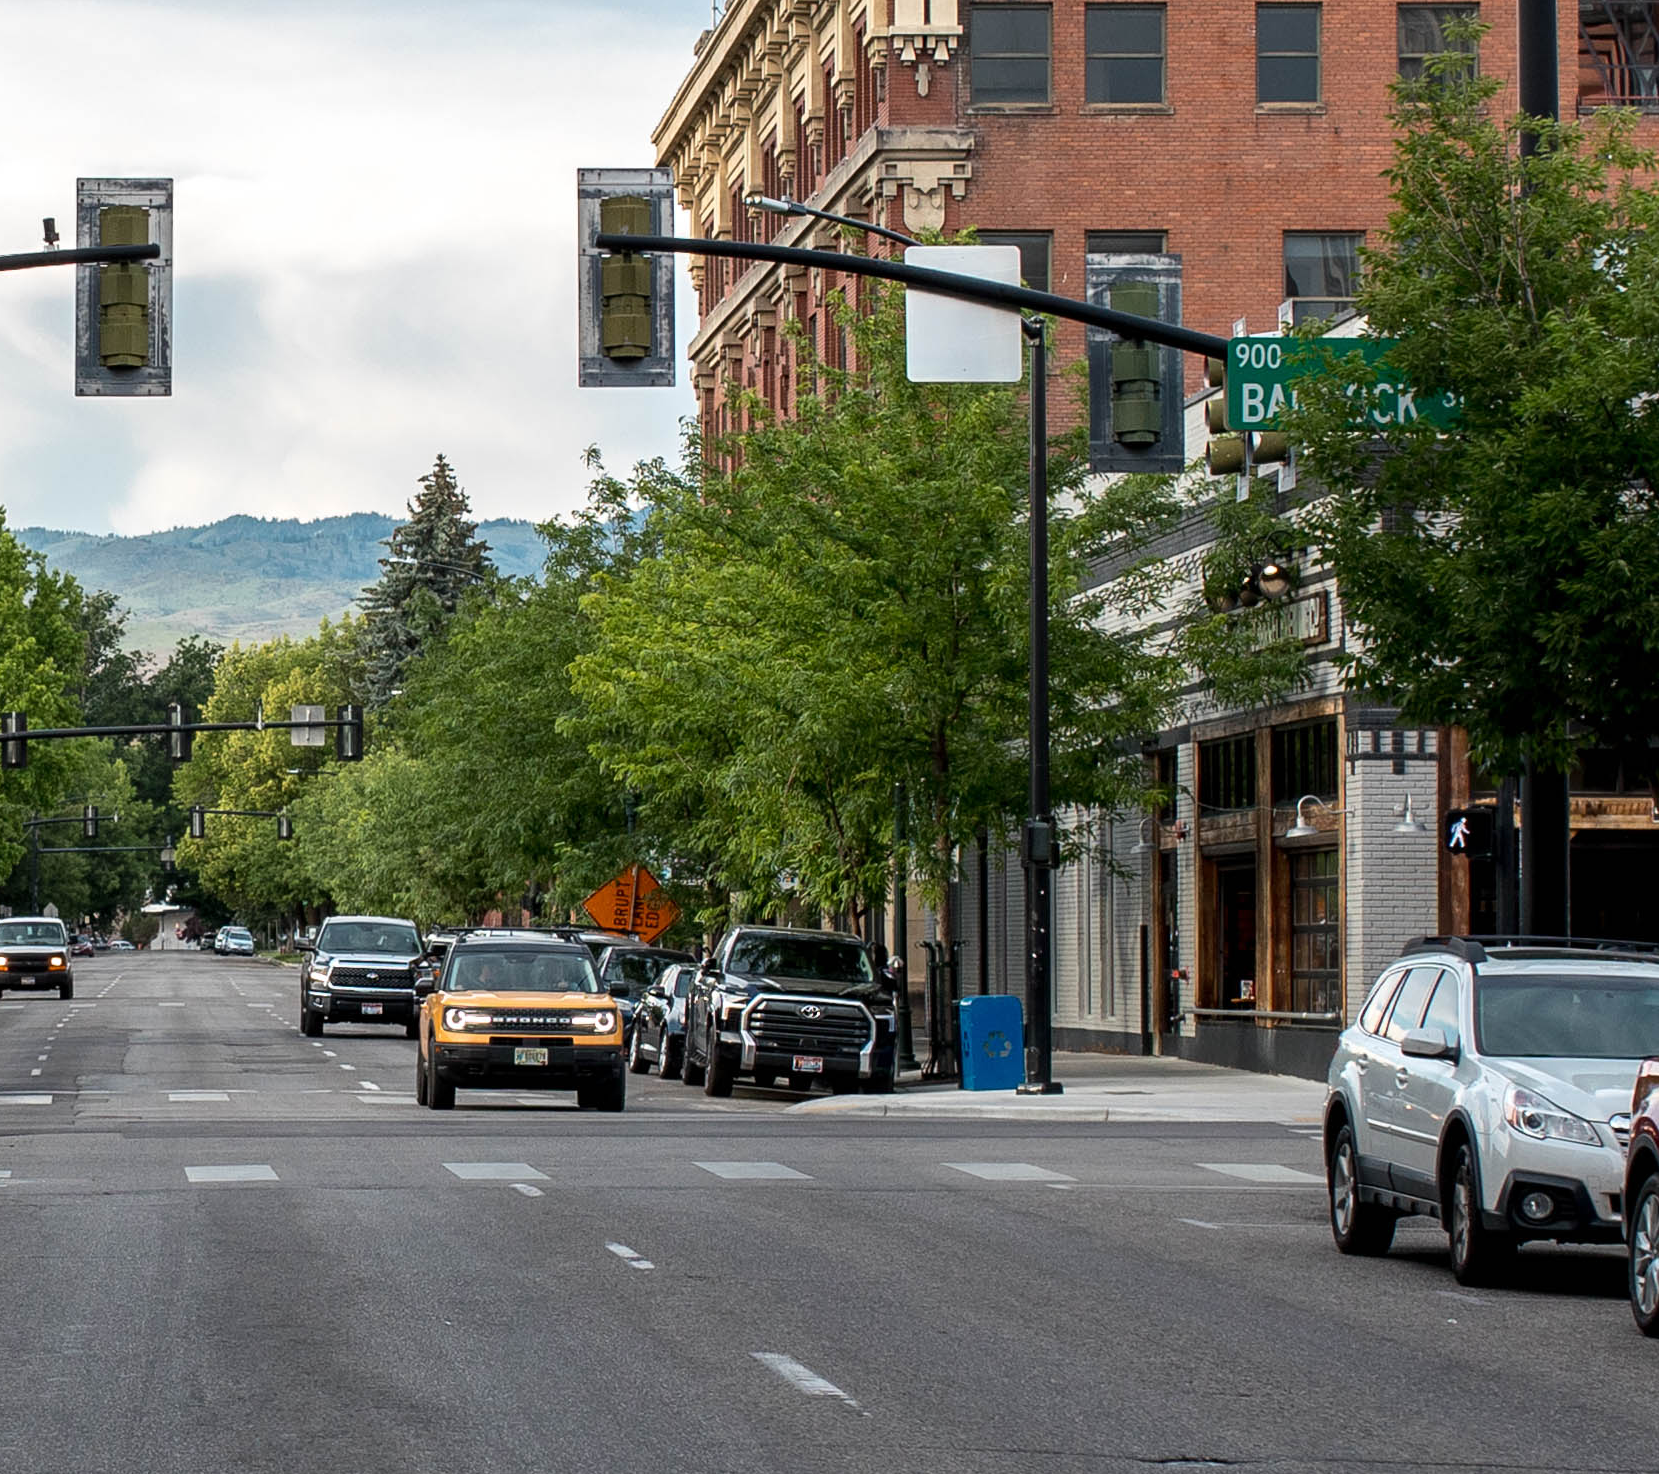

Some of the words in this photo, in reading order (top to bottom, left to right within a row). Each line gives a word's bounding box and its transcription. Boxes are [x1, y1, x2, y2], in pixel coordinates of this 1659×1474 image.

[1236, 343, 1281, 369] 900
[1242, 383, 1418, 424] BAOCK
[613, 880, 631, 927] BRUPT
[492, 1016, 571, 1024] BRONCO
